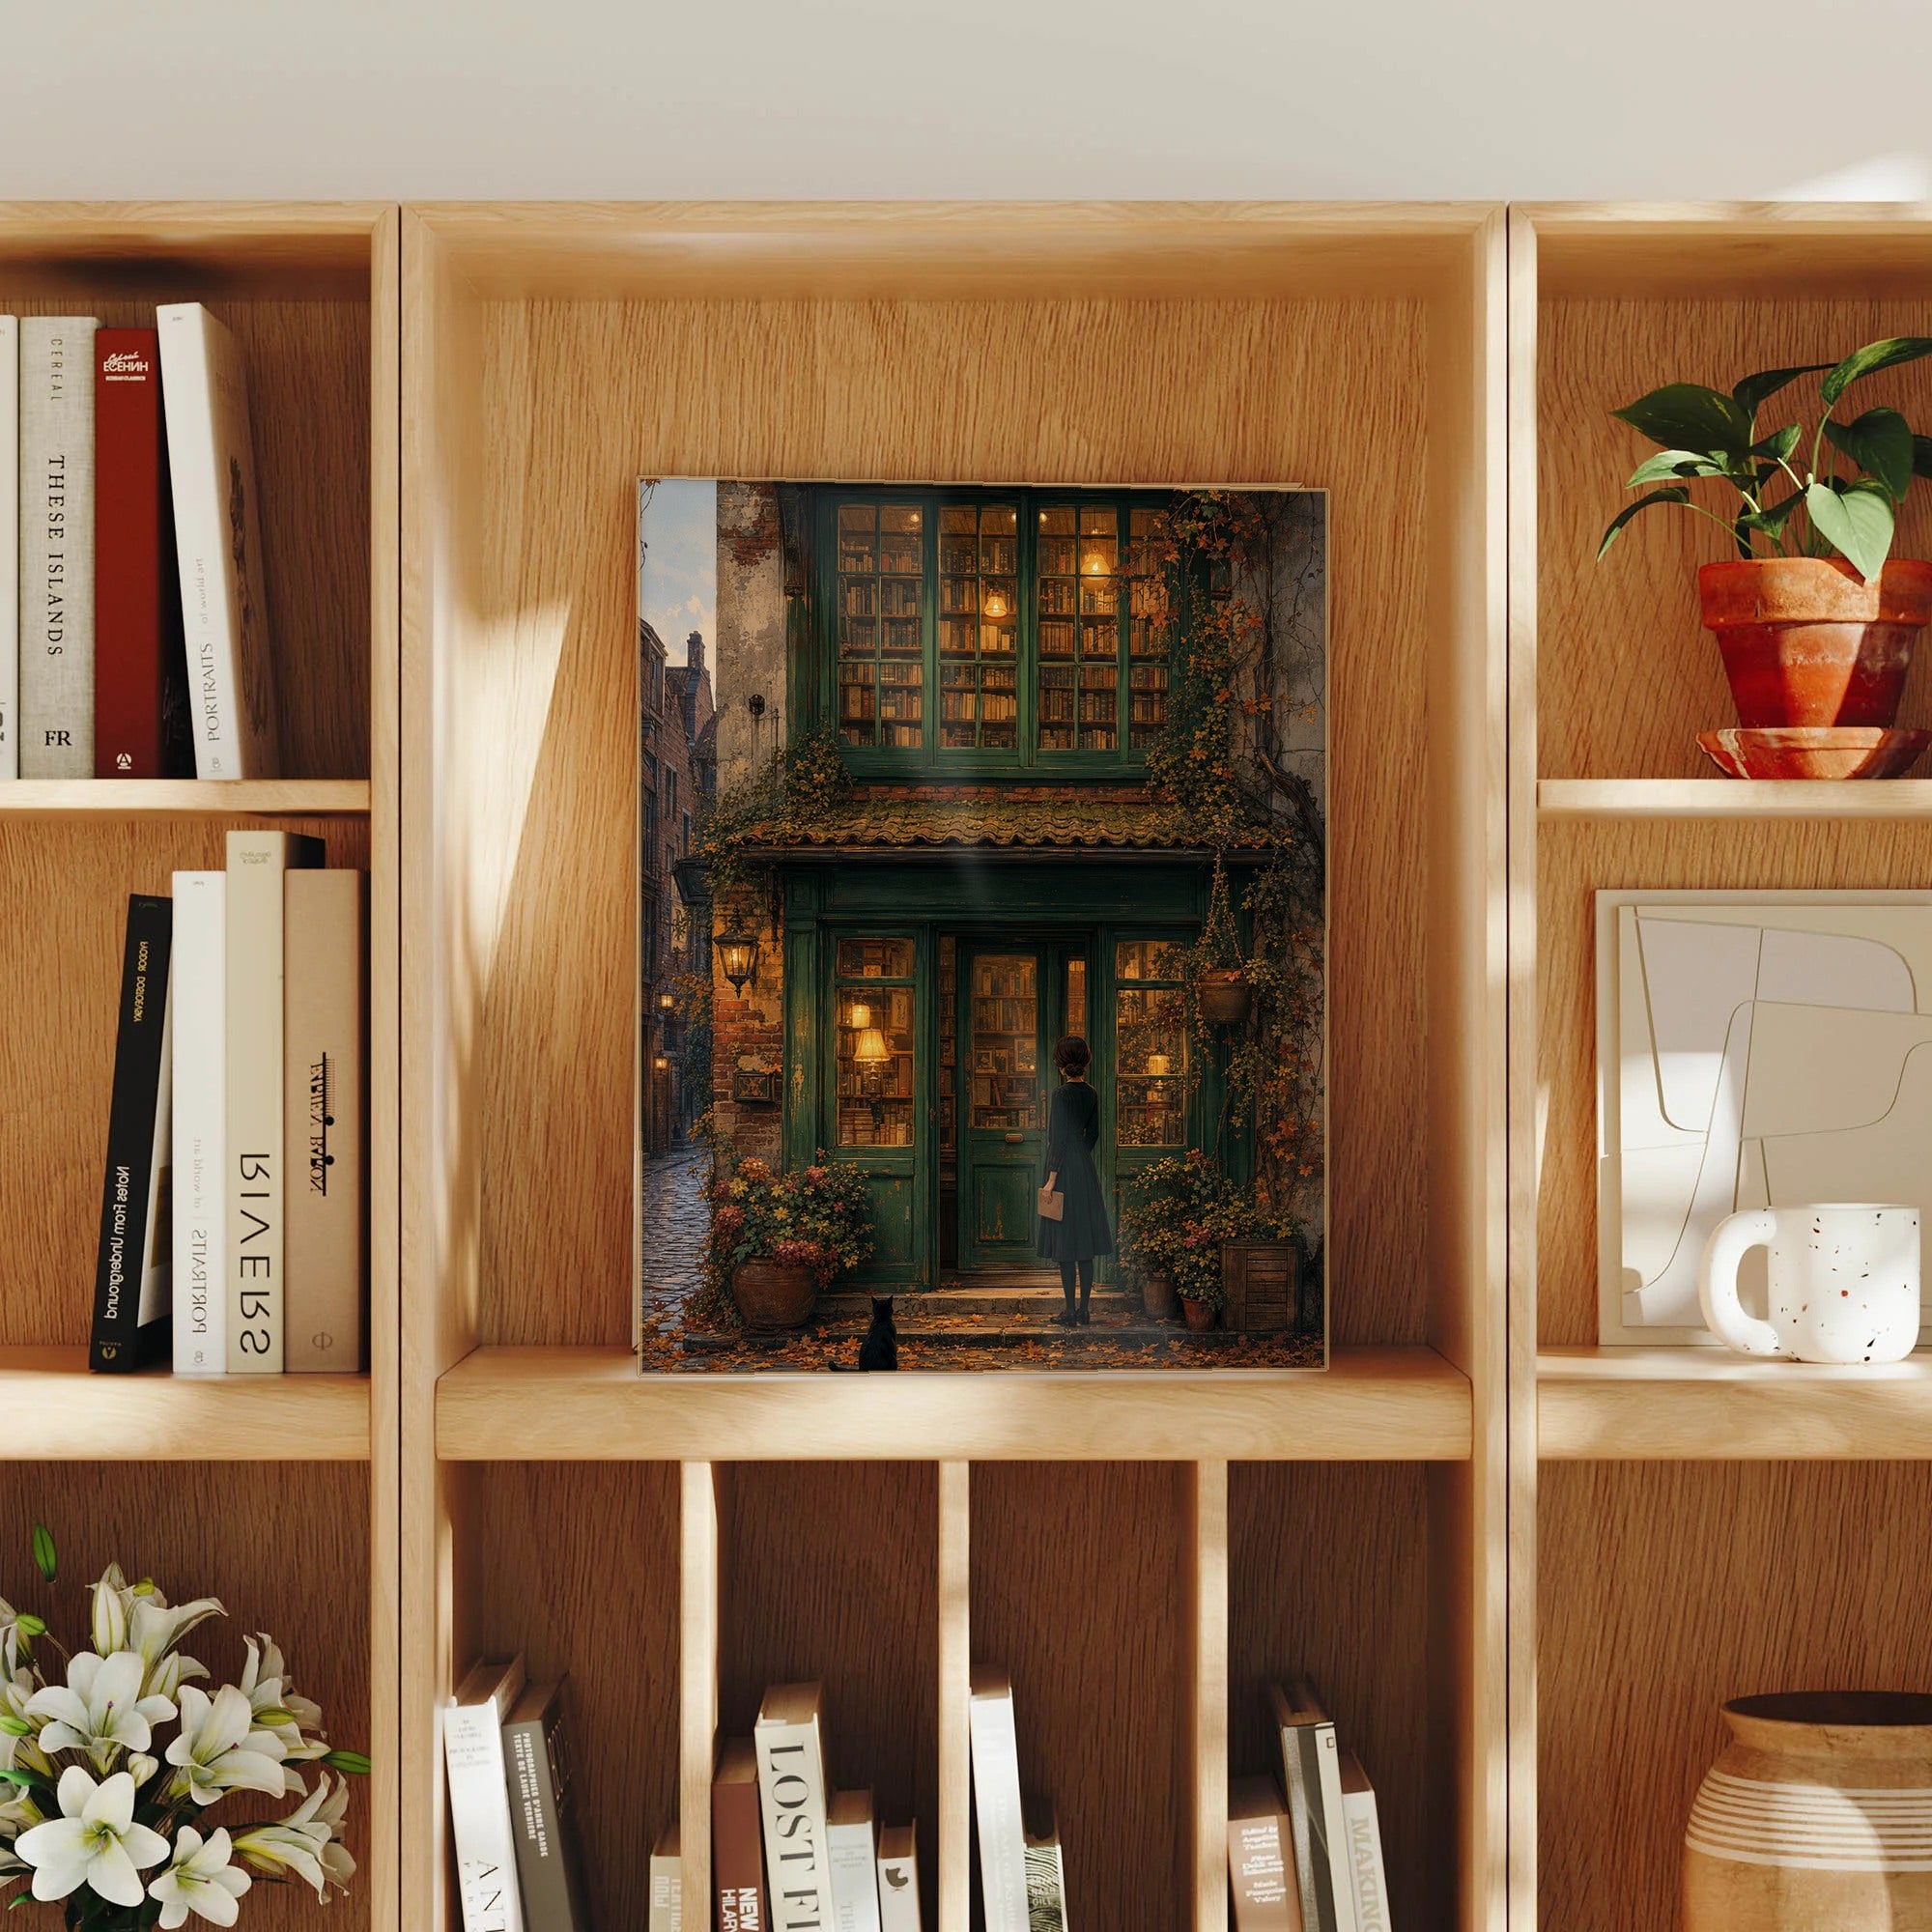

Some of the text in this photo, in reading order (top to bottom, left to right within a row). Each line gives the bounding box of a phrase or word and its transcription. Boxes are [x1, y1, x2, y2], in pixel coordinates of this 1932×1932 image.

[50, 338, 63, 401] CEREAL
[103, 361, 149, 372] ЕСЕНИН
[46, 455, 65, 656] THESE ISLANDS
[200, 642, 221, 742] PORTRAITS
[44, 730, 72, 747] FR
[769, 1741, 816, 1871] LOST
[739, 1887, 759, 1931] NEW
